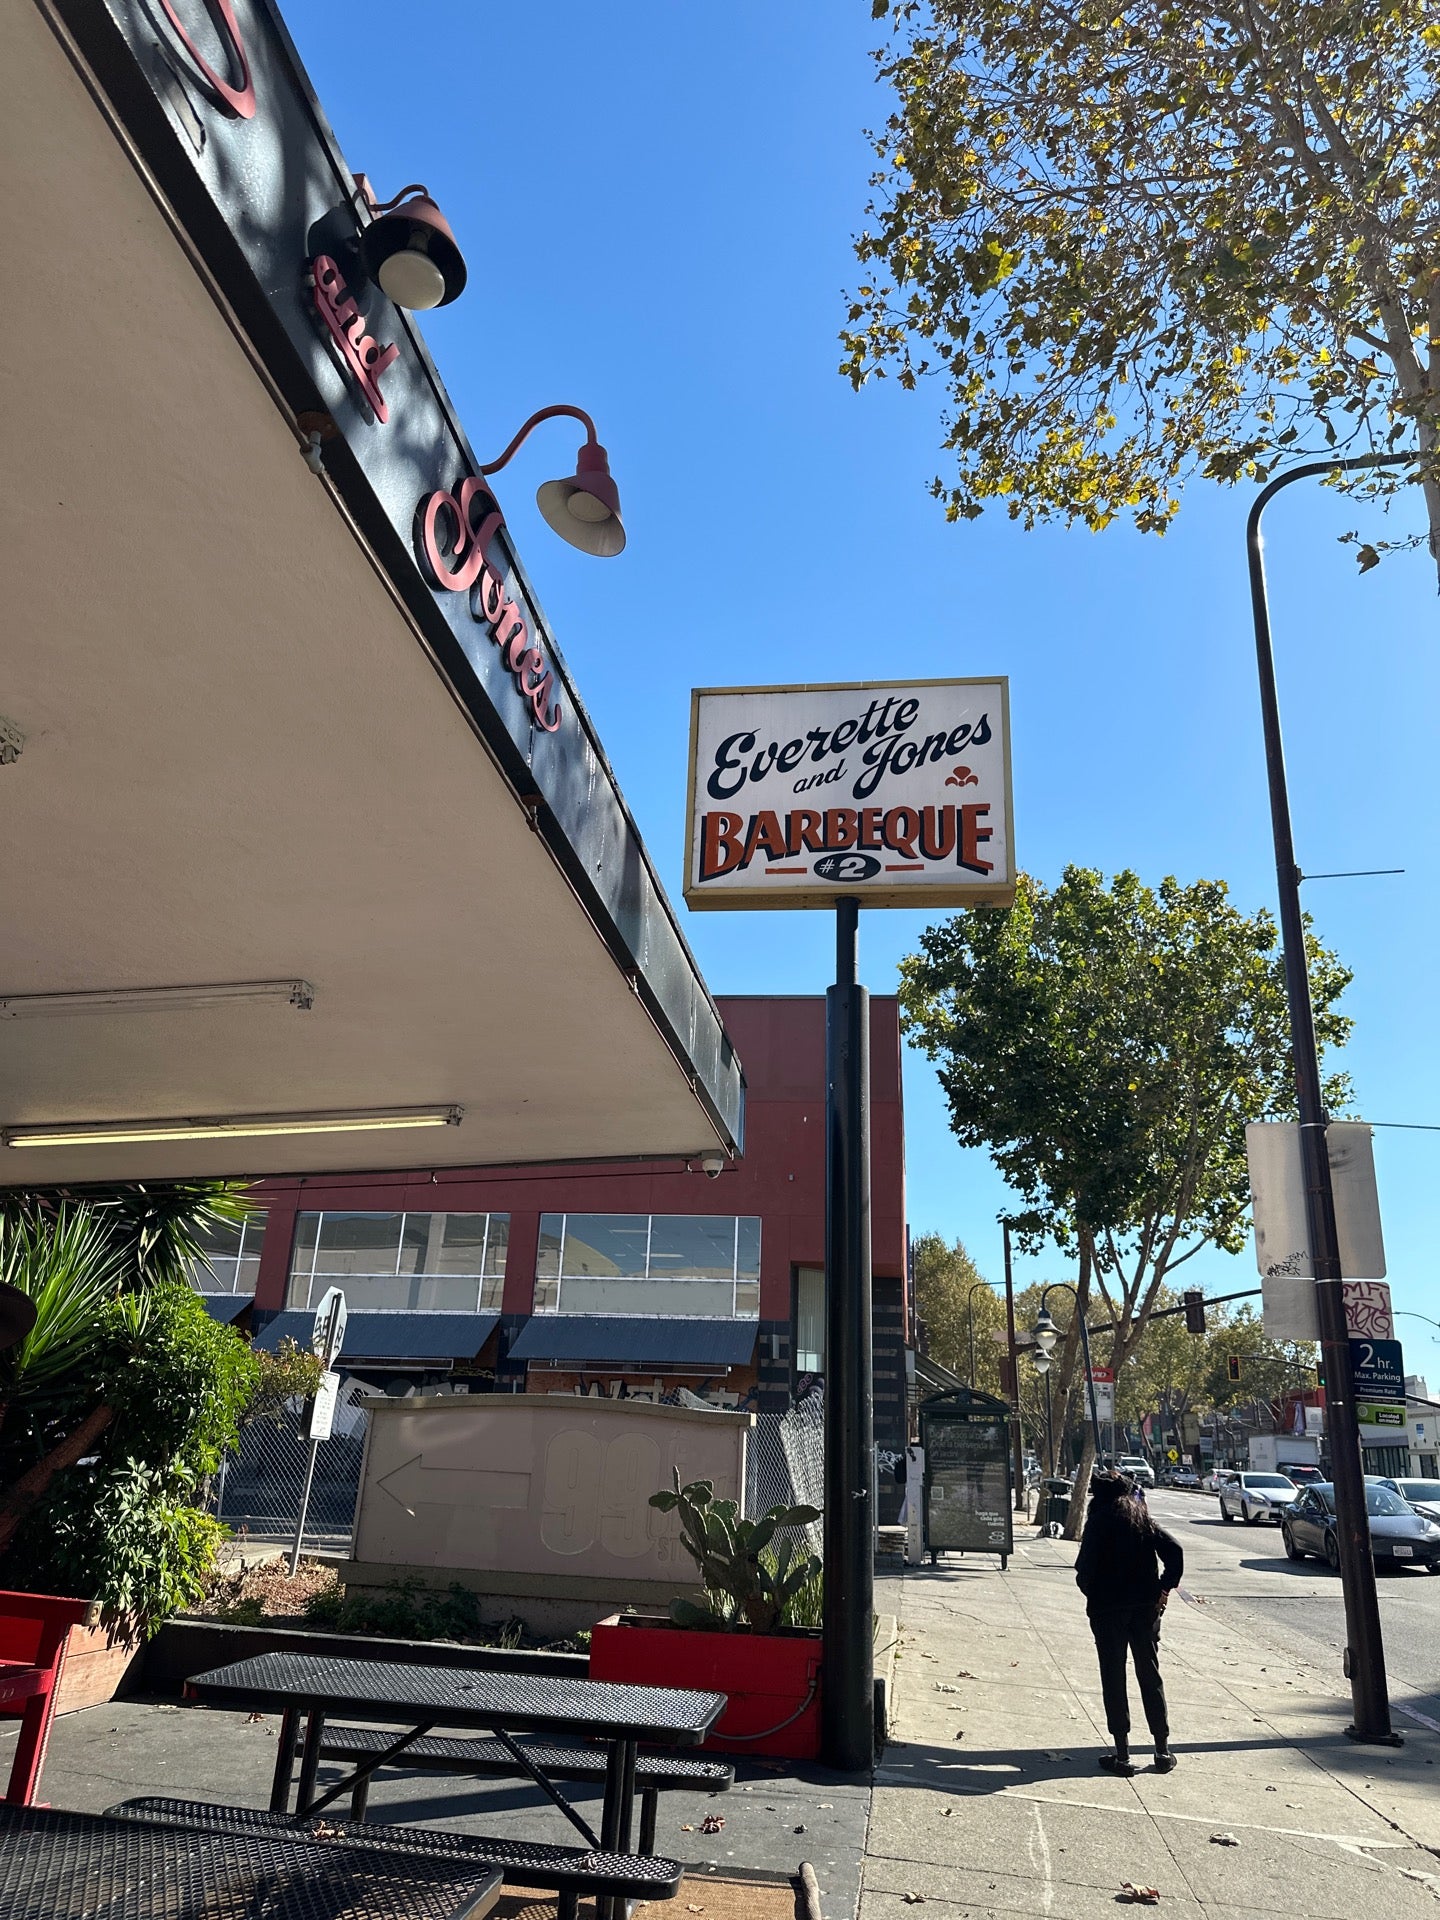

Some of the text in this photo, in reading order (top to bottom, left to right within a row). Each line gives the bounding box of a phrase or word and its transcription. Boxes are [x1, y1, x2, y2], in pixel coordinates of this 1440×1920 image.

[314, 254, 562, 732] and Jones
[707, 696, 919, 800] Everette
[793, 713, 992, 800] and Jones
[699, 803, 994, 883] BARBEQUE
[1354, 1371, 1401, 1383] Max. Parking
[1360, 1343, 1394, 1369] 2 hr.
[1360, 1386, 1383, 1394] Premium
